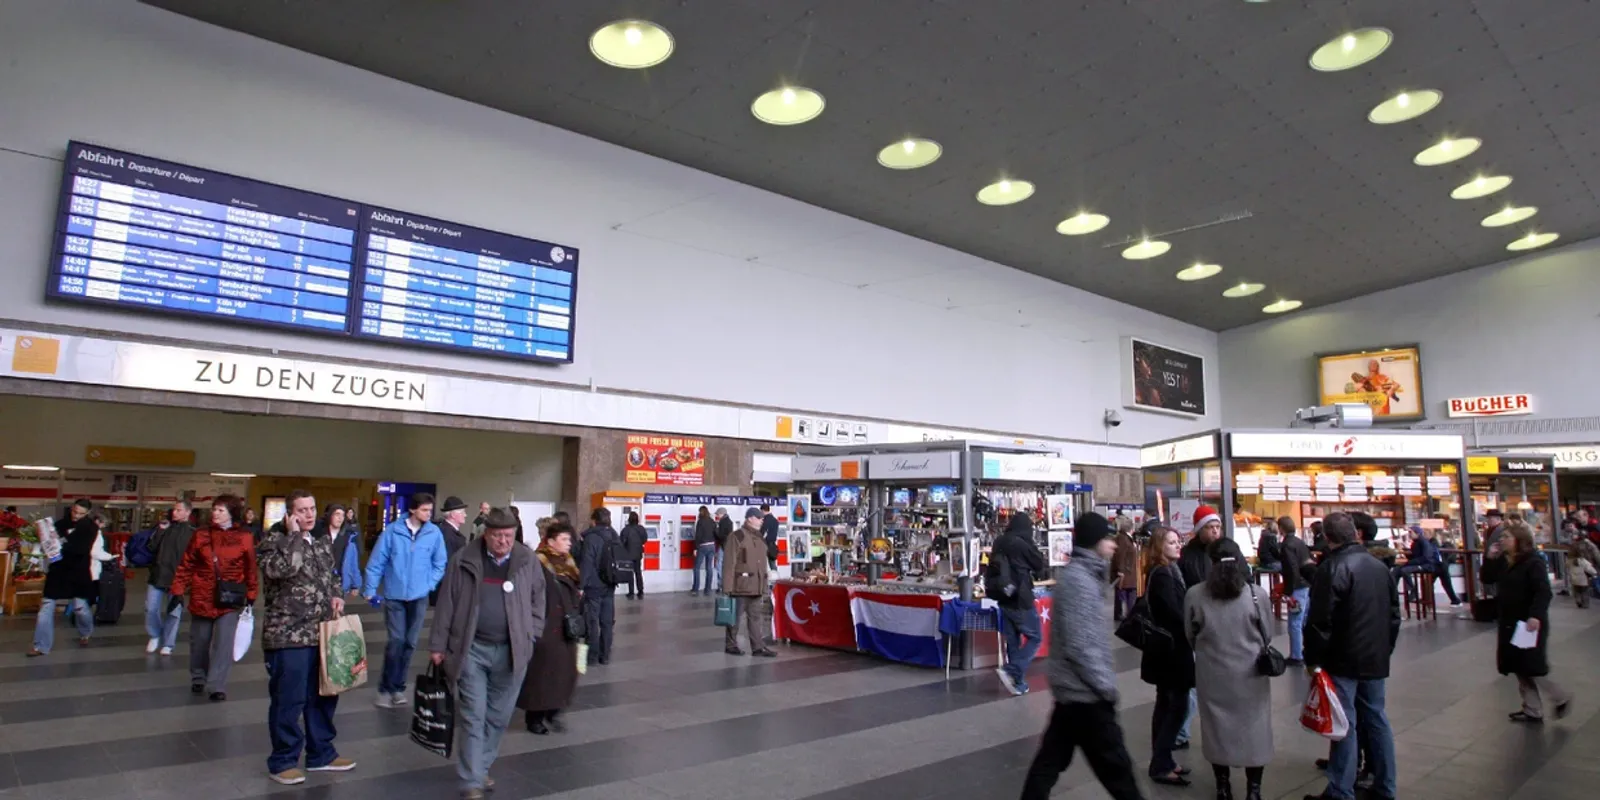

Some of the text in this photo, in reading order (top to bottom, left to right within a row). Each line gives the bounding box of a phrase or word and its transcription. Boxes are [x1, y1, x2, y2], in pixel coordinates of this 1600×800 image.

[78, 149, 125, 168] Abfahrt
[128, 161, 172, 178] Departure
[371, 211, 404, 226] Abfahrt
[406, 220, 439, 233] Departure
[63, 264, 87, 274] 14:41
[195, 360, 426, 402] ZU DEN ZÜGEN
